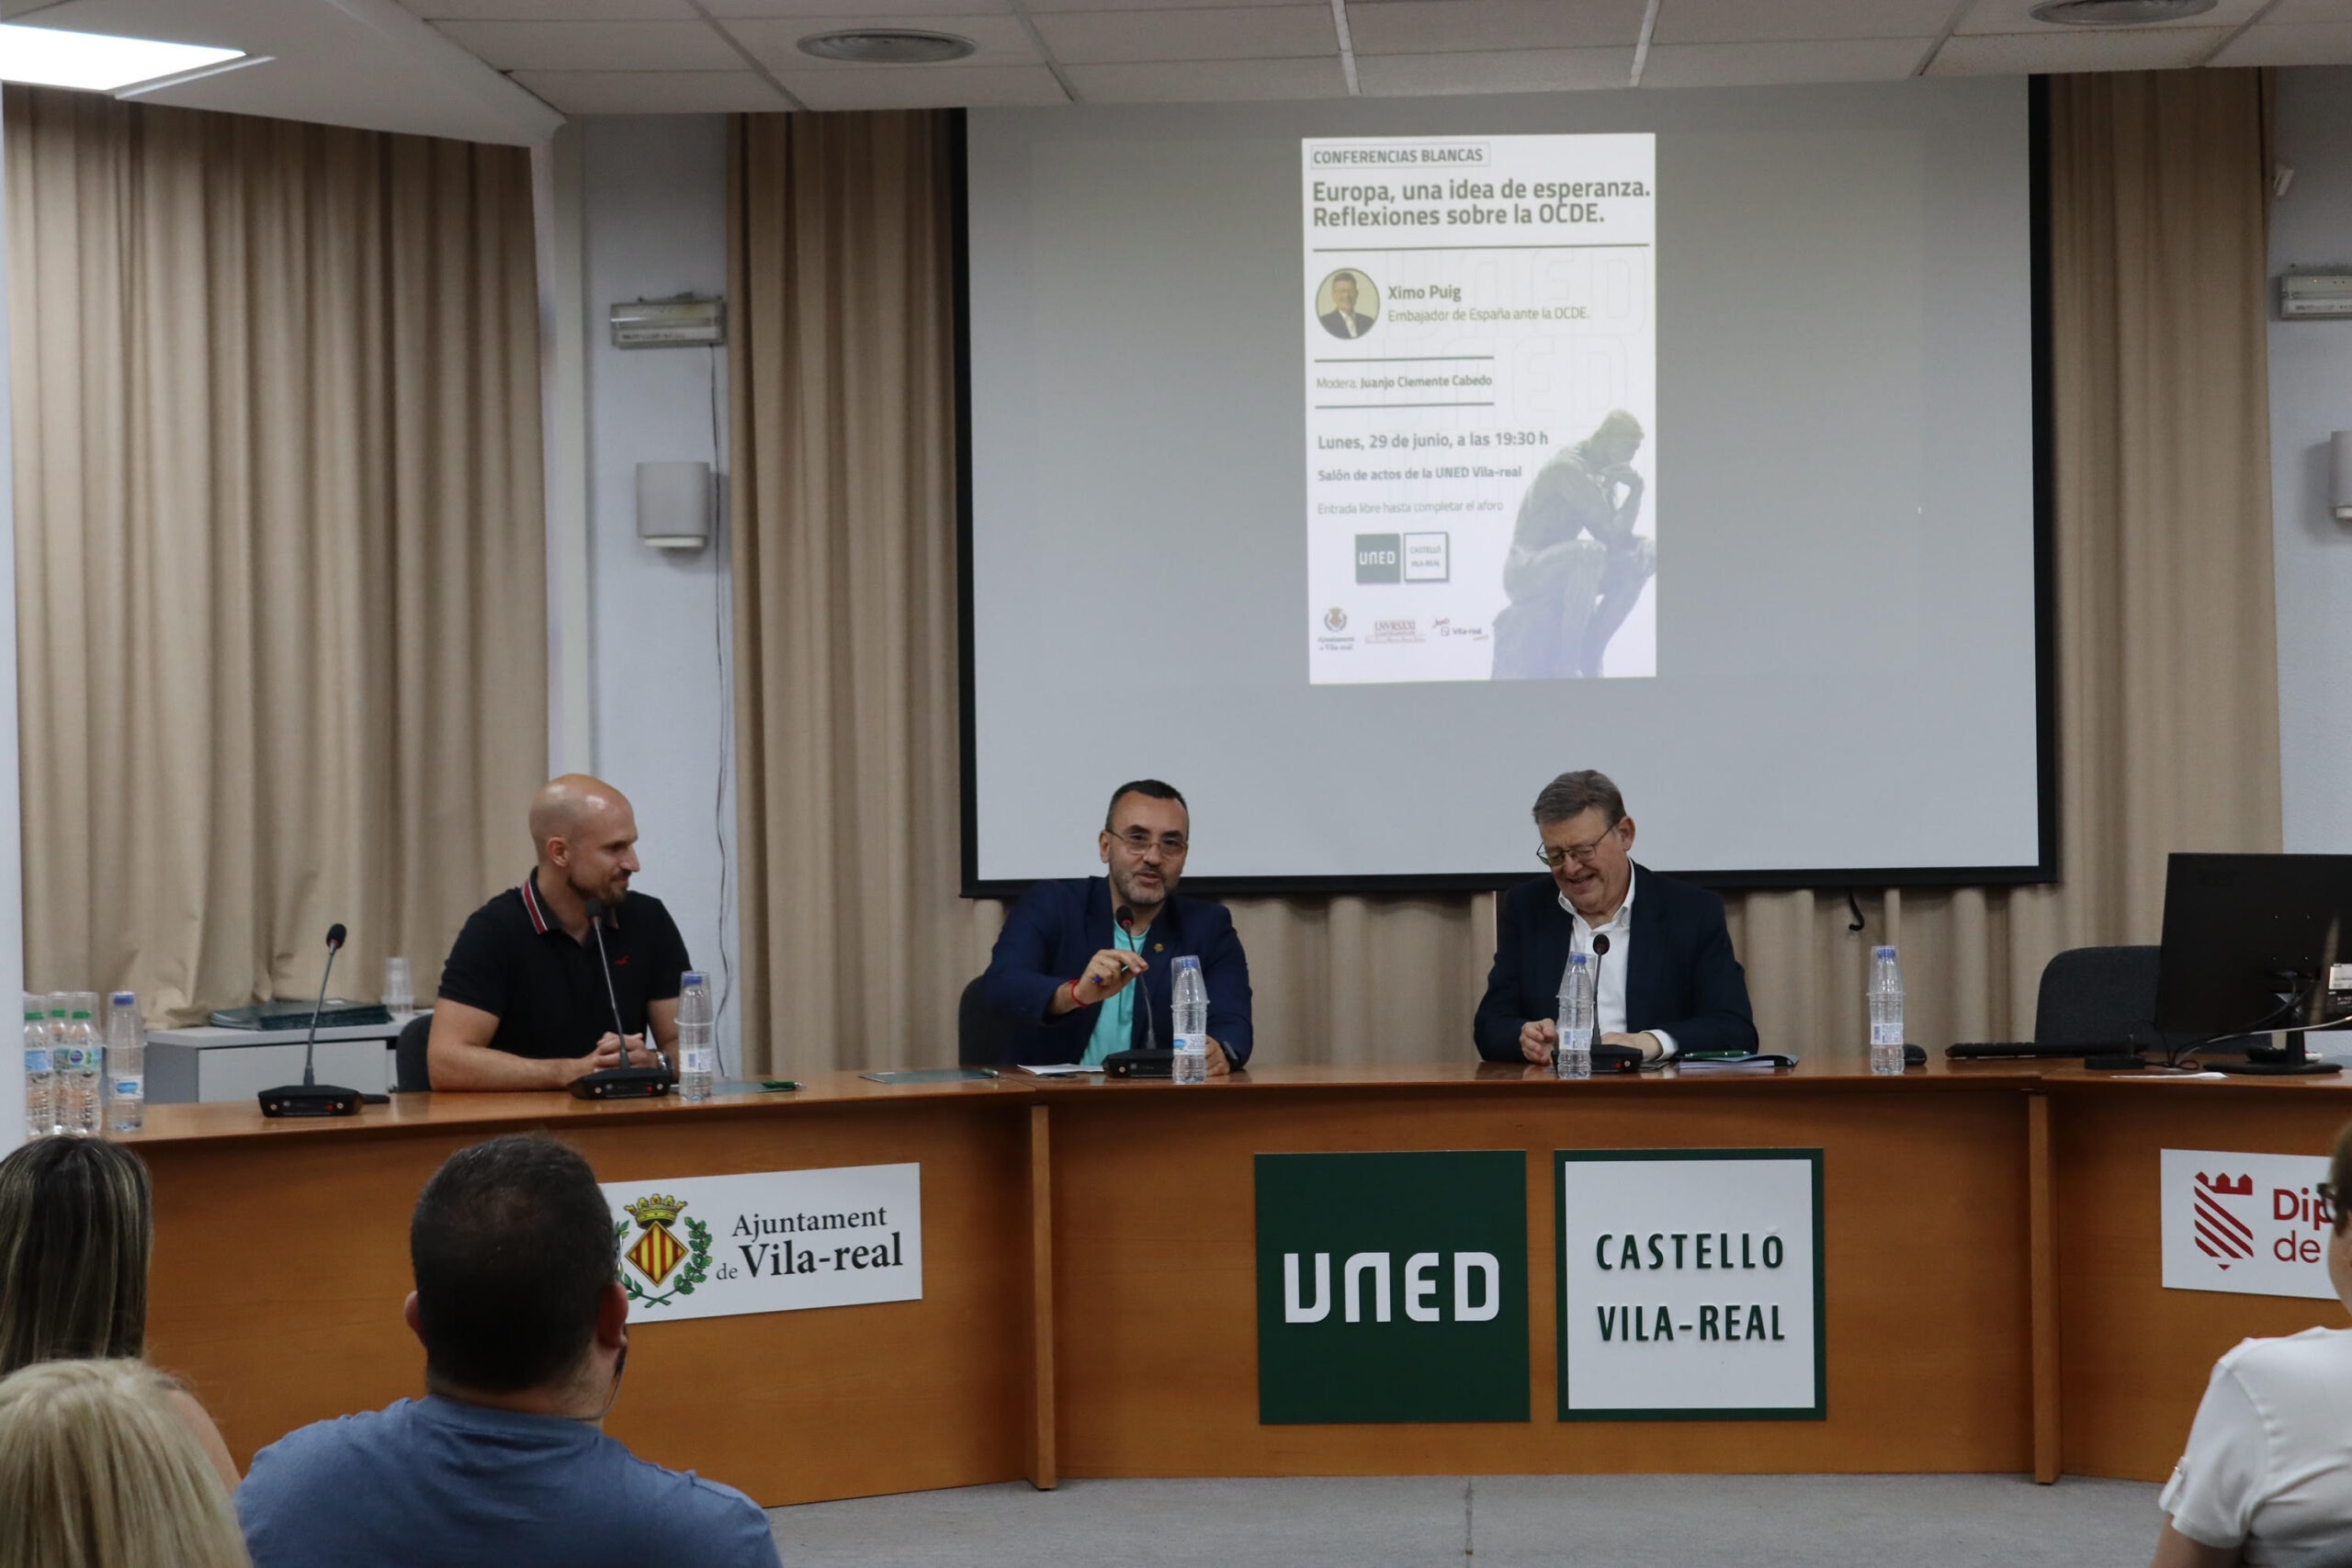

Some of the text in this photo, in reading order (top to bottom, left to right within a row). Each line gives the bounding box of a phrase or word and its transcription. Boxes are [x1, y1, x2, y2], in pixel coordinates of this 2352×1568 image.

[1313, 148, 1484, 165] CONFERENCIAS BLANCAS
[1312, 178, 1651, 207] Europa, una idea de esperanza.
[1312, 202, 1605, 227] Reflexiones sobre la OCDE.
[1387, 285, 1462, 302] Ximo Puig
[1387, 307, 1591, 324] Embajador de España ante la OCDE.
[1316, 374, 1493, 391] Modera: Juanjo Clemente Cabedo
[1317, 432, 1548, 451] Lunes, 29 de junio, a las 19:30 h
[1317, 465, 1521, 481] Salón de actos de la UNED Vila-real
[1317, 500, 1504, 514] Entrada libre hasta completar el aforo
[731, 1206, 888, 1242] Ajuntament
[716, 1231, 904, 1280] de Vila-real
[2273, 1229, 2321, 1263] de
[1283, 1251, 1499, 1323] UNED
[1597, 1304, 1786, 1342] VILA-REAL
